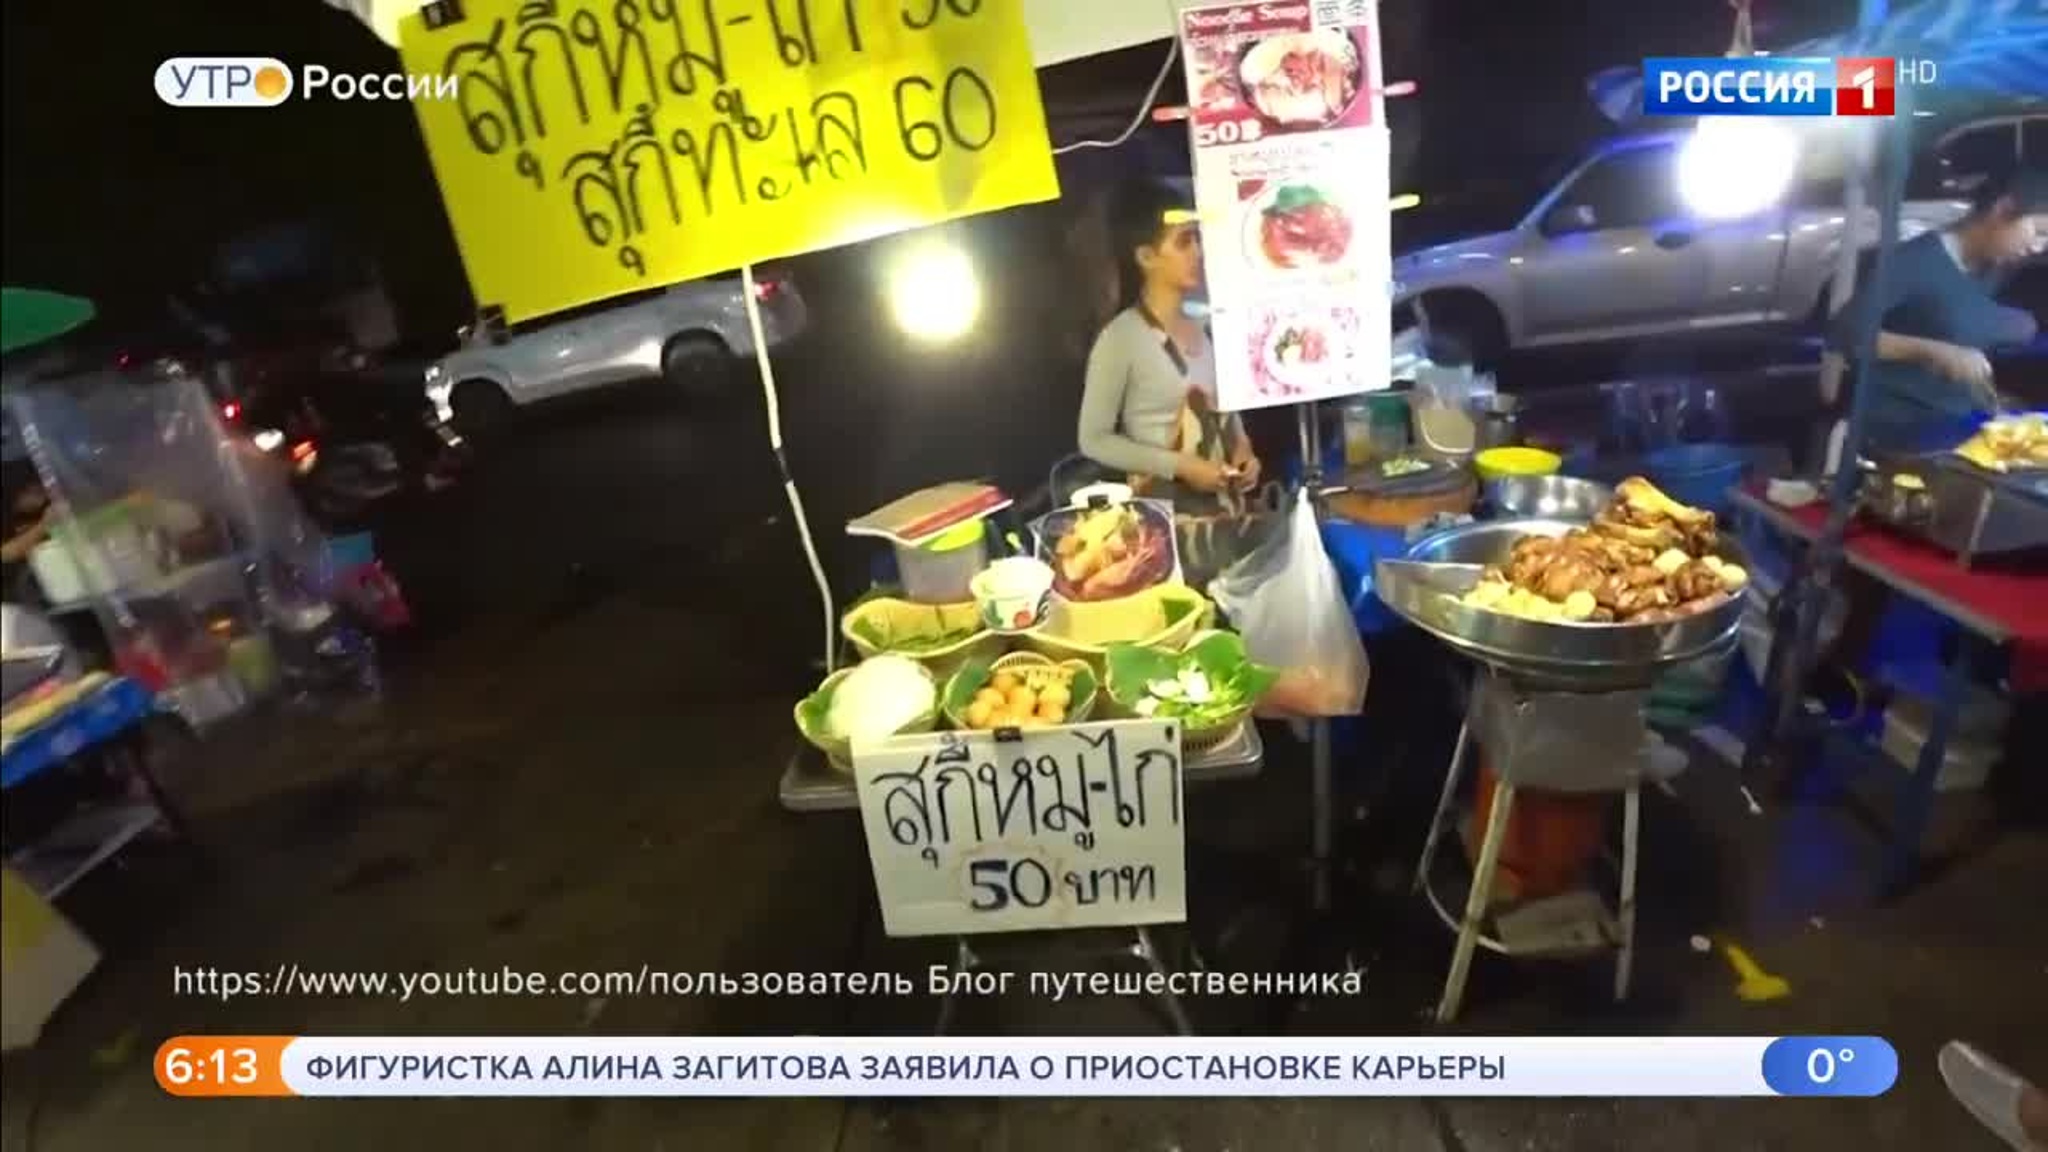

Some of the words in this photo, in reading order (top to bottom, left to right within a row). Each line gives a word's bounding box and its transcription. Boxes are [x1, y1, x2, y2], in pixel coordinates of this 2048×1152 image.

[893, 66, 997, 161] 60
[970, 857, 1052, 911] 50
[1064, 864, 1156, 905] บาท
